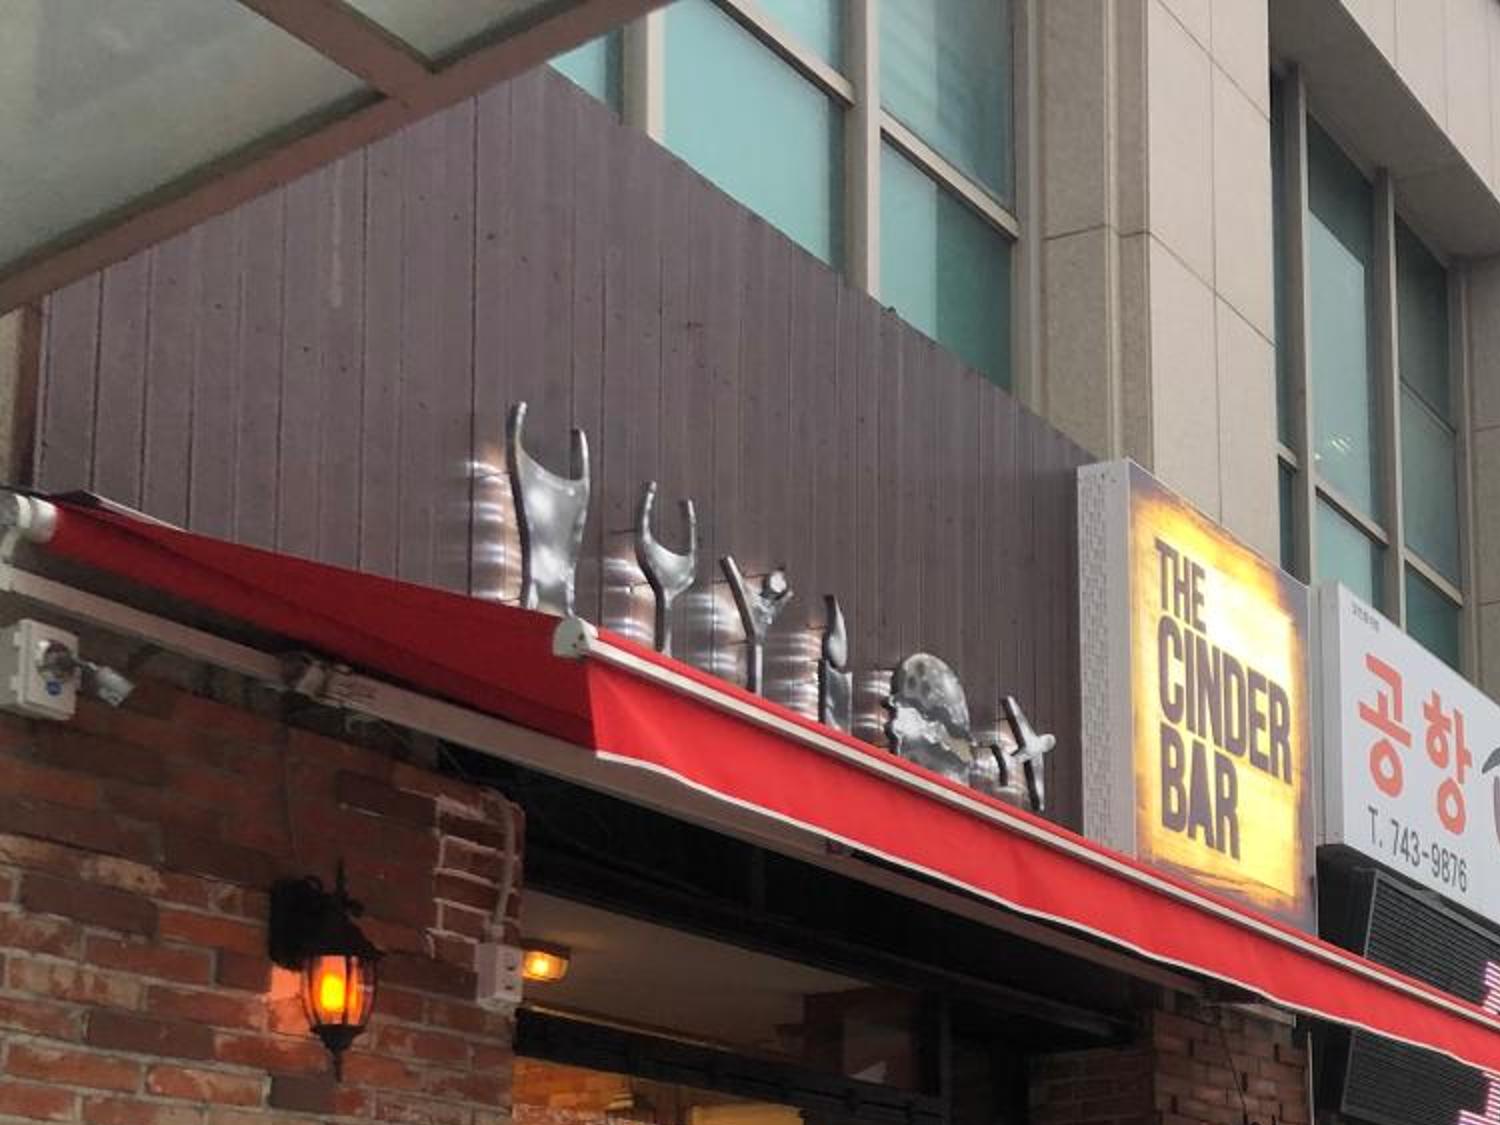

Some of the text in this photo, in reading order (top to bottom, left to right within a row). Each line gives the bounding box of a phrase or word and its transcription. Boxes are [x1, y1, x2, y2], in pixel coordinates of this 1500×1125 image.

[1155, 537, 1207, 634] THE
[1157, 615, 1293, 786] CINDER
[1358, 652, 1473, 836] 공항
[1160, 722, 1240, 861] BAR
[1368, 806, 1468, 893] T. 743-9876
